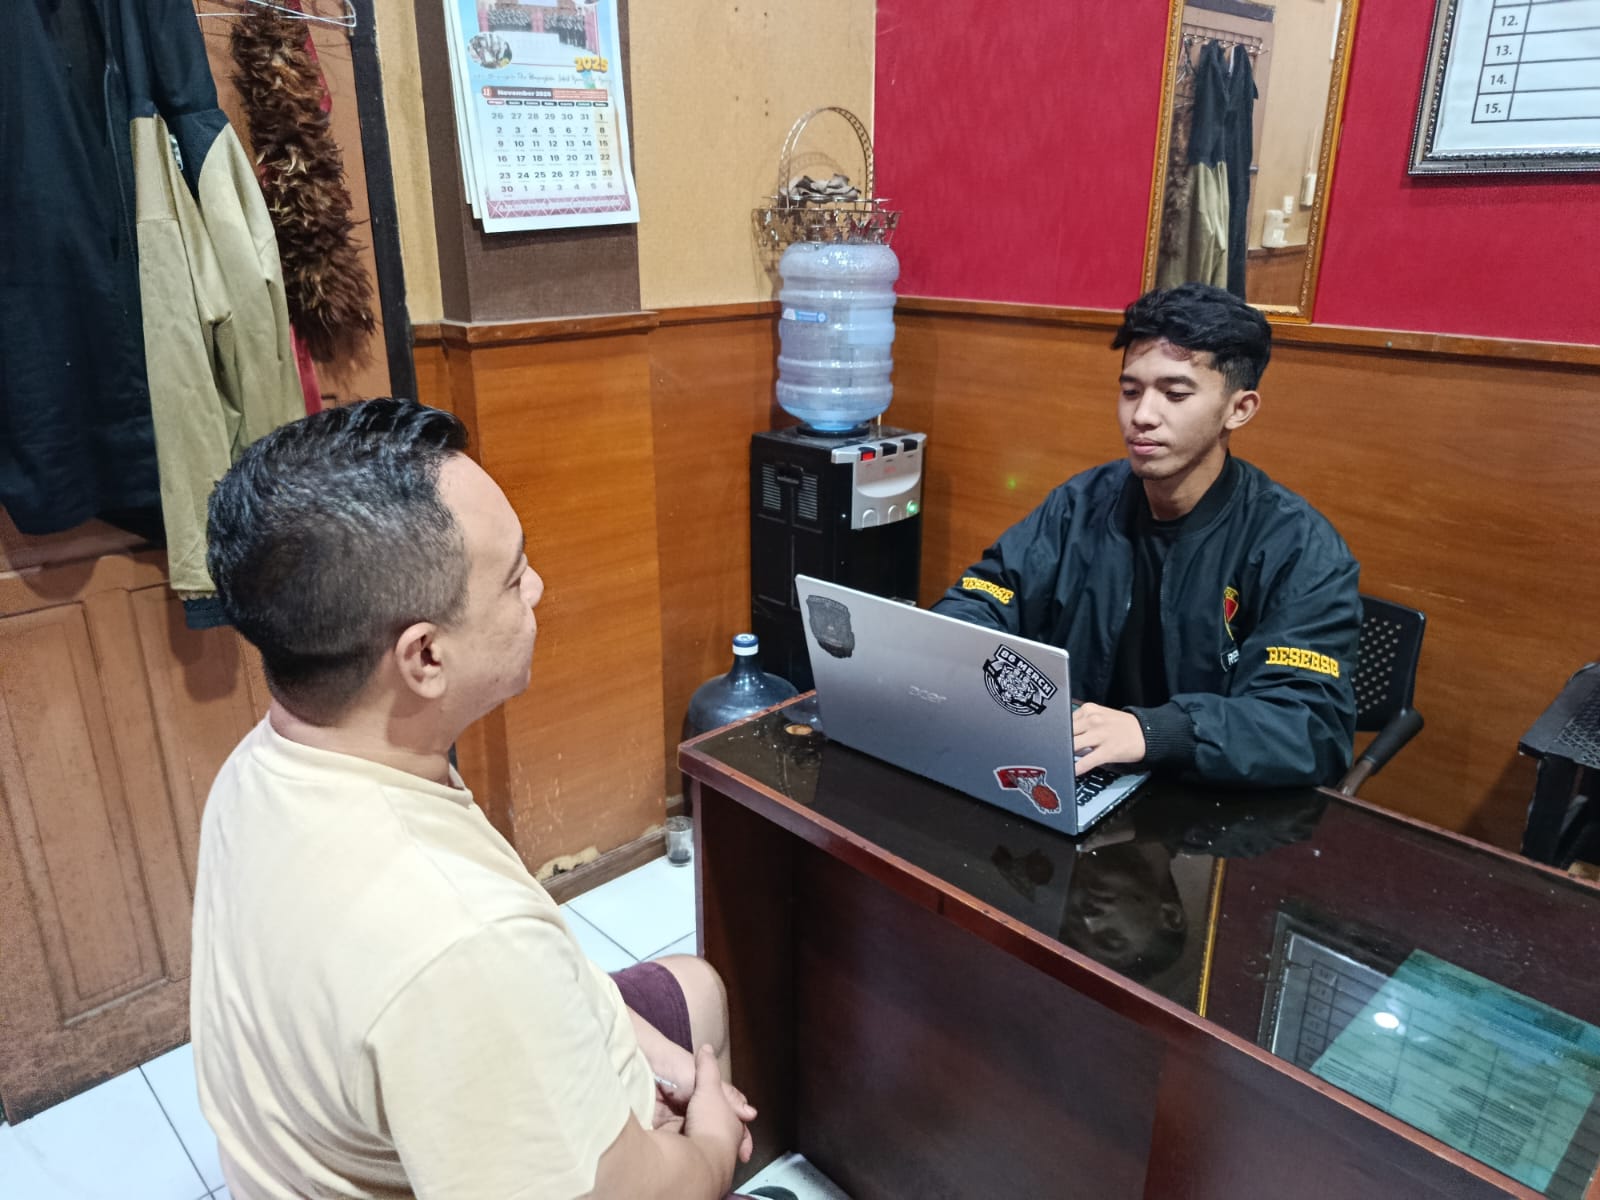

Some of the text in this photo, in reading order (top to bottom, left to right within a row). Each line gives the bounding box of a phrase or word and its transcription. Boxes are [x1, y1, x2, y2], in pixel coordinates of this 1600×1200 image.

[1501, 15, 1518, 27] 12.
[1495, 45, 1512, 56] 13.
[574, 55, 609, 72] 2025
[1490, 74, 1507, 85] 14.
[1485, 103, 1501, 114] 15.
[1265, 646, 1340, 678] RESERSE
[1000, 650, 1052, 694] 86 MERCH
[908, 685, 947, 704] acer
